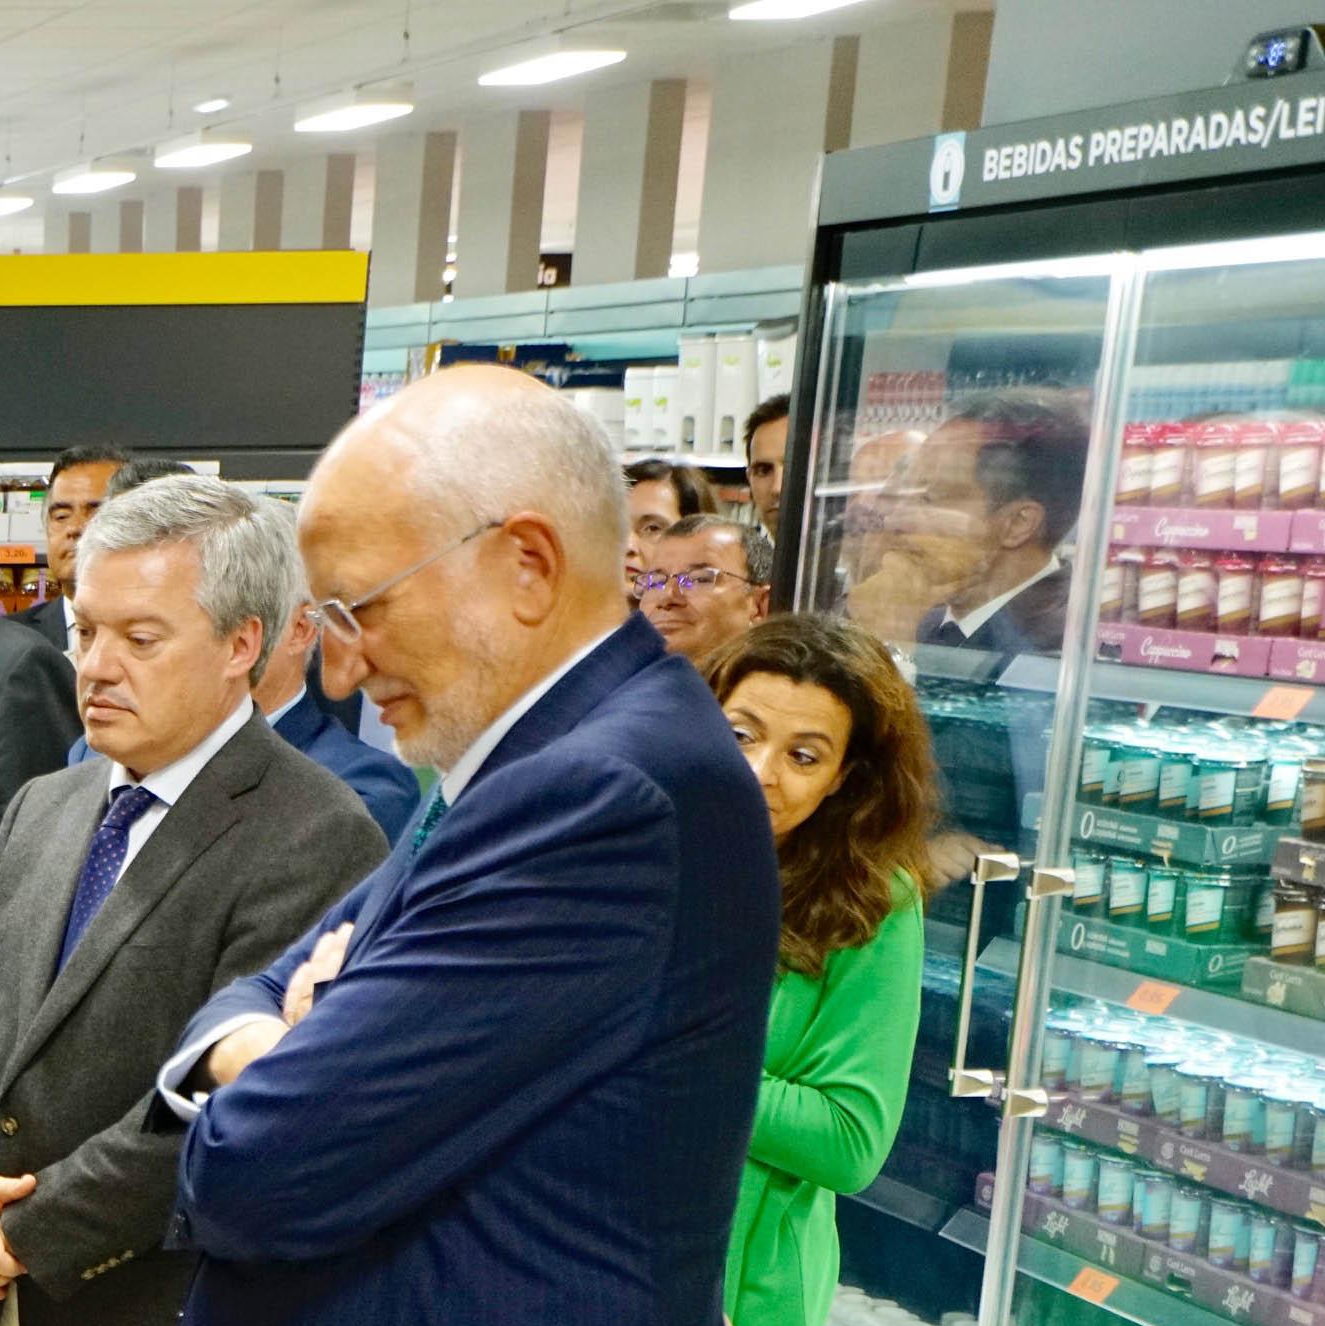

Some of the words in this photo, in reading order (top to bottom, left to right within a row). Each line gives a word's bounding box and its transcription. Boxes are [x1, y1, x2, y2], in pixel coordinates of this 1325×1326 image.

[982, 134, 1084, 182] BEBIDAS
[1058, 1104, 1086, 1131] Light
[1238, 1168, 1273, 1198] Light
[1042, 1210, 1069, 1239] Light
[1222, 1284, 1255, 1316] Light
